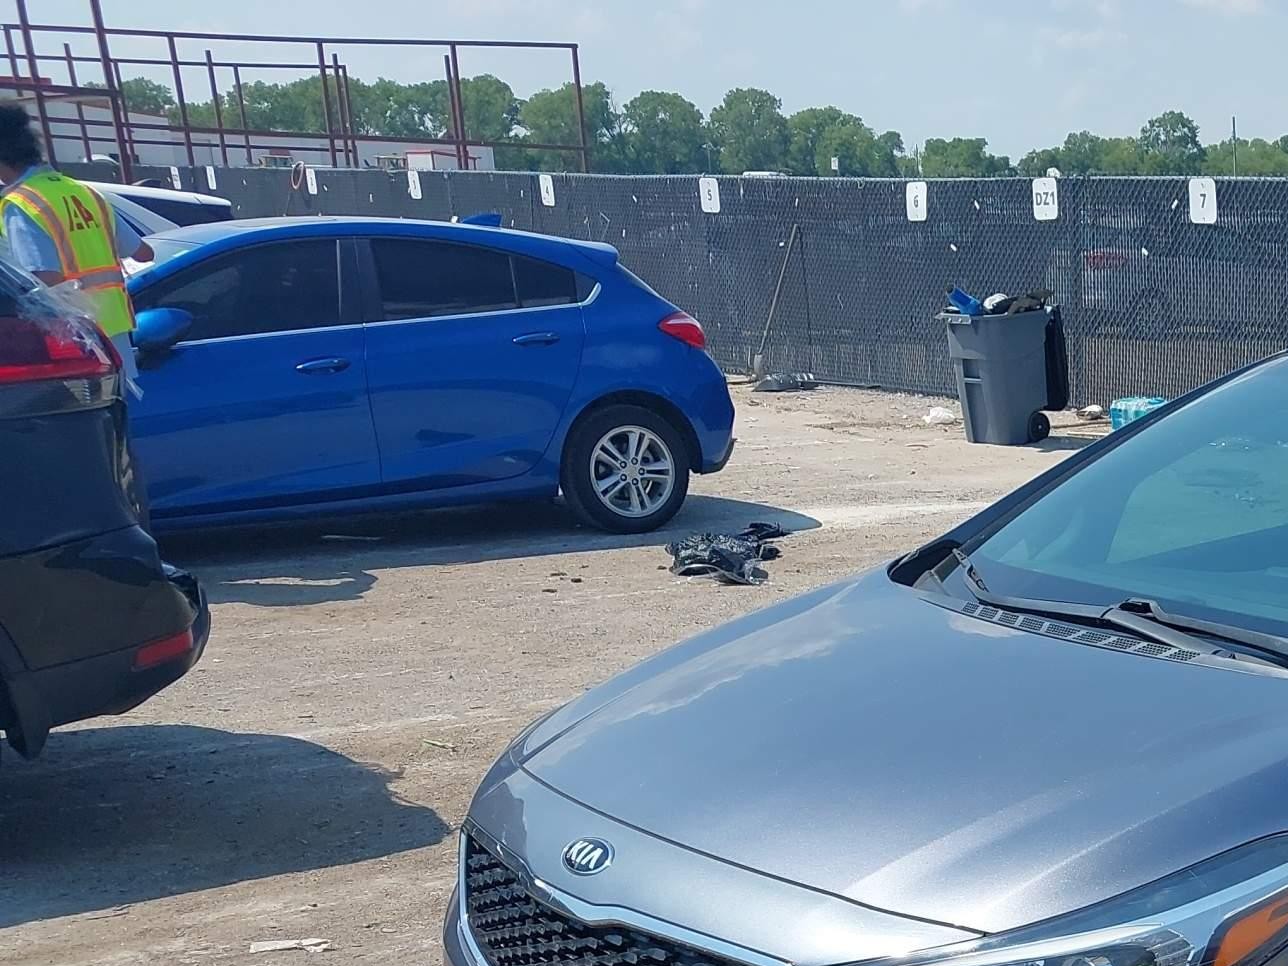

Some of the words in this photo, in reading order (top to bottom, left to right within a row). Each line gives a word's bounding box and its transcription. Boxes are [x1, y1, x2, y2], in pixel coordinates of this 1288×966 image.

[707, 189, 712, 201] 5
[913, 194, 919, 208] 6
[1035, 191, 1056, 206] DZ1
[1200, 193, 1206, 208] 7
[565, 840, 604, 870] KIA
